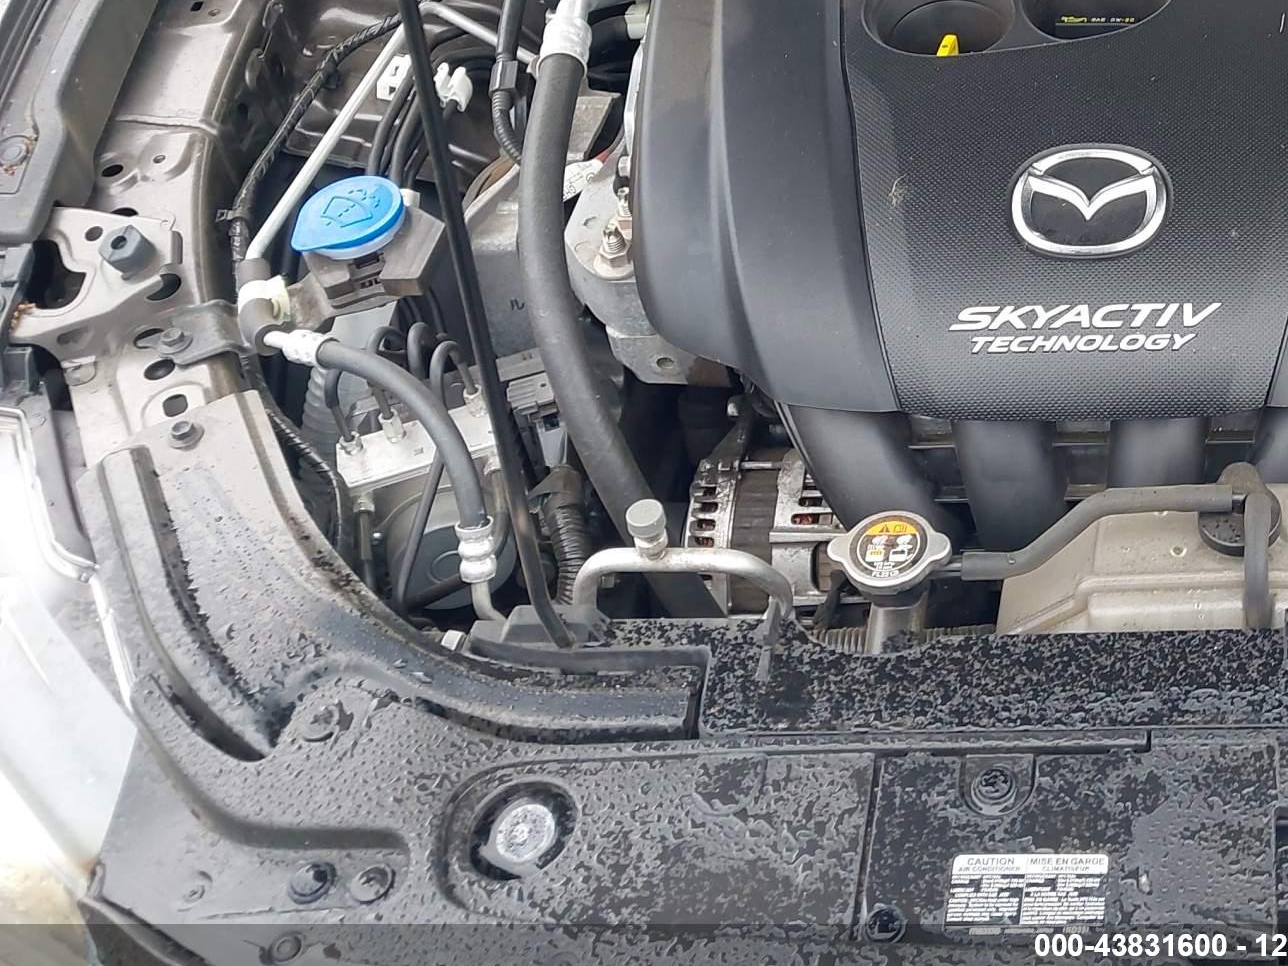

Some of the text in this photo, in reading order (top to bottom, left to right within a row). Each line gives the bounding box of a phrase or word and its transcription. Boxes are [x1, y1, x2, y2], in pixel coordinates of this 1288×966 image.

[949, 302, 1222, 331] SKYACTIV
[971, 333, 1197, 354] TECHNOLOGY
[967, 857, 1015, 865] CAUTION
[1030, 857, 1105, 865] MISE EN GARDE
